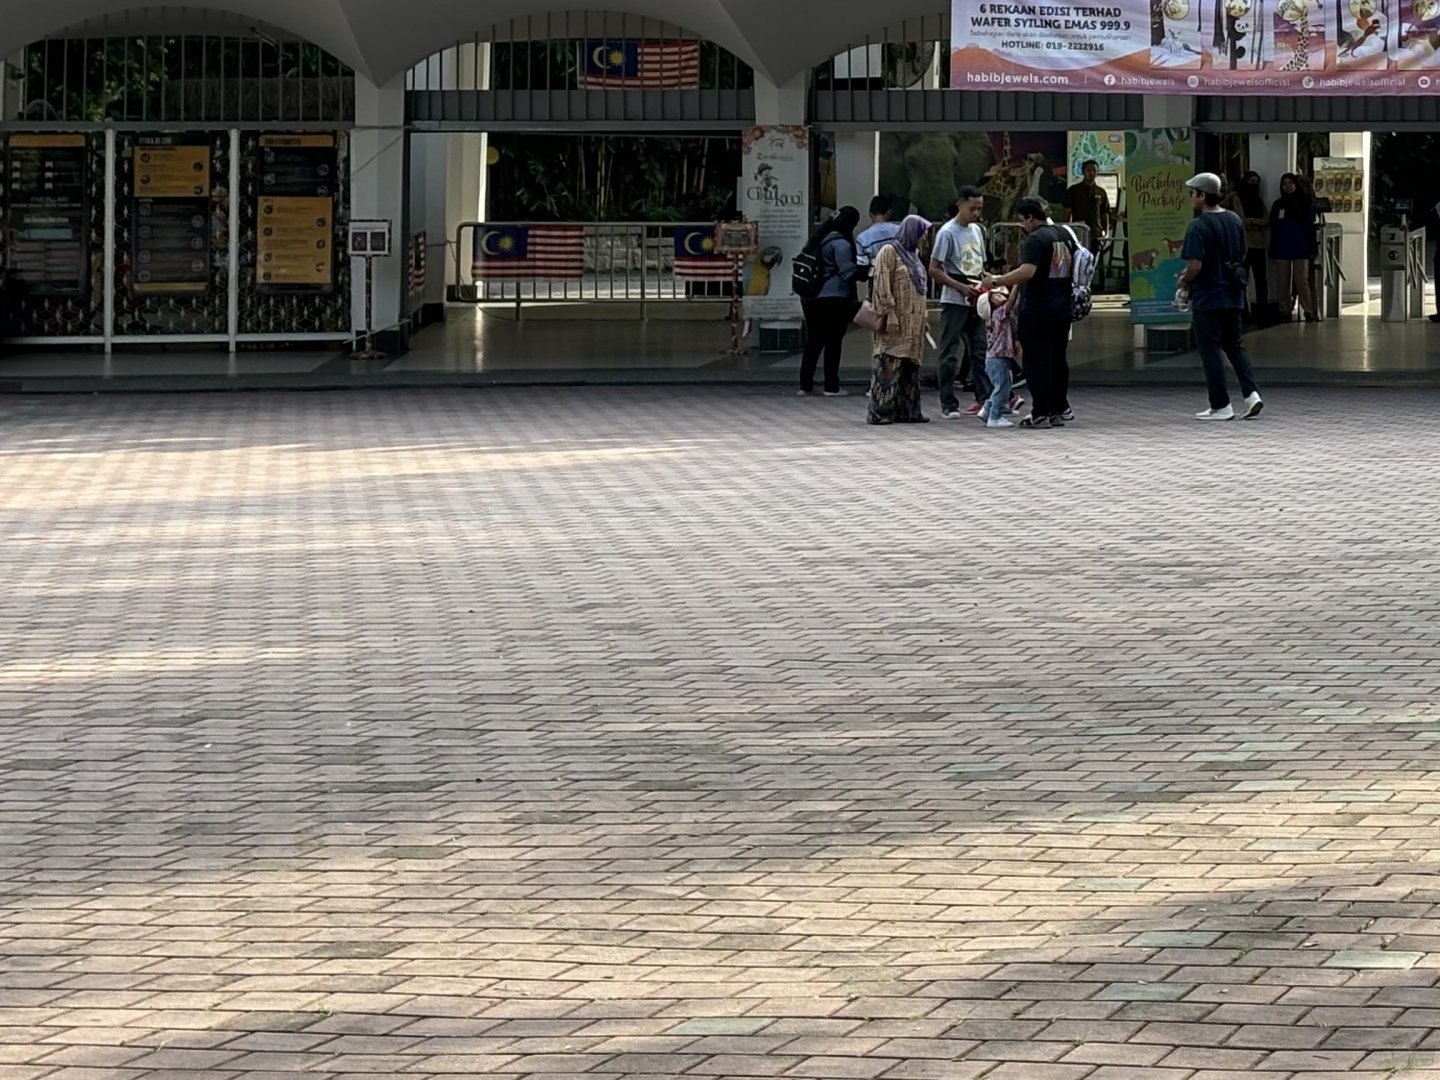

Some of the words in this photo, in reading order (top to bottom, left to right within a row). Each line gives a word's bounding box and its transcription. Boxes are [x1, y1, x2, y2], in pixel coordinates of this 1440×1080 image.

[979, 3, 987, 14] 6
[989, 4, 1037, 16] REKAAN
[1039, 6, 1071, 16] EDISI
[1074, 7, 1122, 18] TERHAD
[970, 17, 1011, 28] WAFER
[1065, 20, 1097, 30] EMAS
[1100, 20, 1131, 31] 999.9
[1001, 41, 1044, 50] HOTLINE:
[966, 72, 1069, 85] habibjewels.com
[1120, 76, 1175, 87] habibjewels
[1203, 77, 1290, 89] habibjewelsofficial
[1319, 77, 1406, 89] habibjewelsofficial
[1131, 172, 1184, 193] Birthday
[1137, 190, 1186, 211] Package
